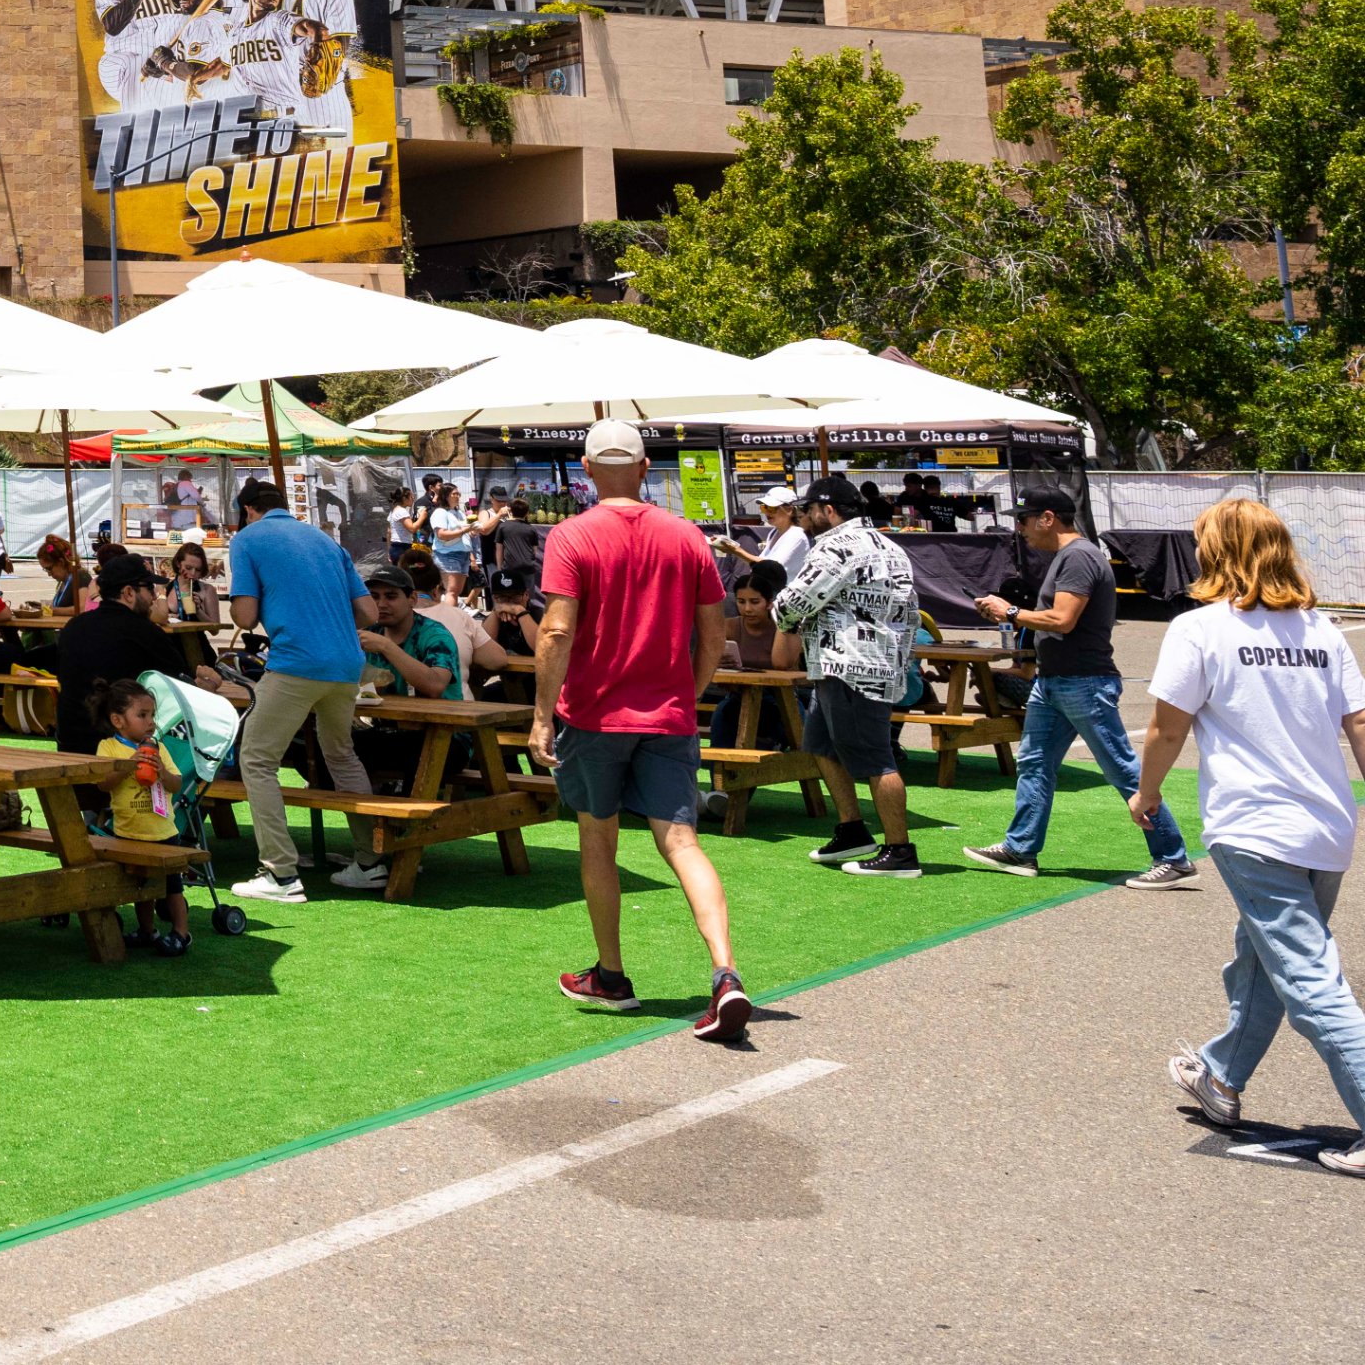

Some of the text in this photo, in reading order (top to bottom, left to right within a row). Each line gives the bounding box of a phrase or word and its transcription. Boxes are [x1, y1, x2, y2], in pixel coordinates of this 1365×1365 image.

[93, 94, 295, 191] TIME TO
[179, 141, 389, 245] SHINE
[523, 428, 588, 441] Pineapp
[741, 430, 989, 444] Gourmet Grilled Cheese
[840, 589, 890, 606] BATMAN
[1238, 646, 1329, 669] COPELAND
[846, 663, 866, 675] CITY
[867, 666, 878, 675] AT
